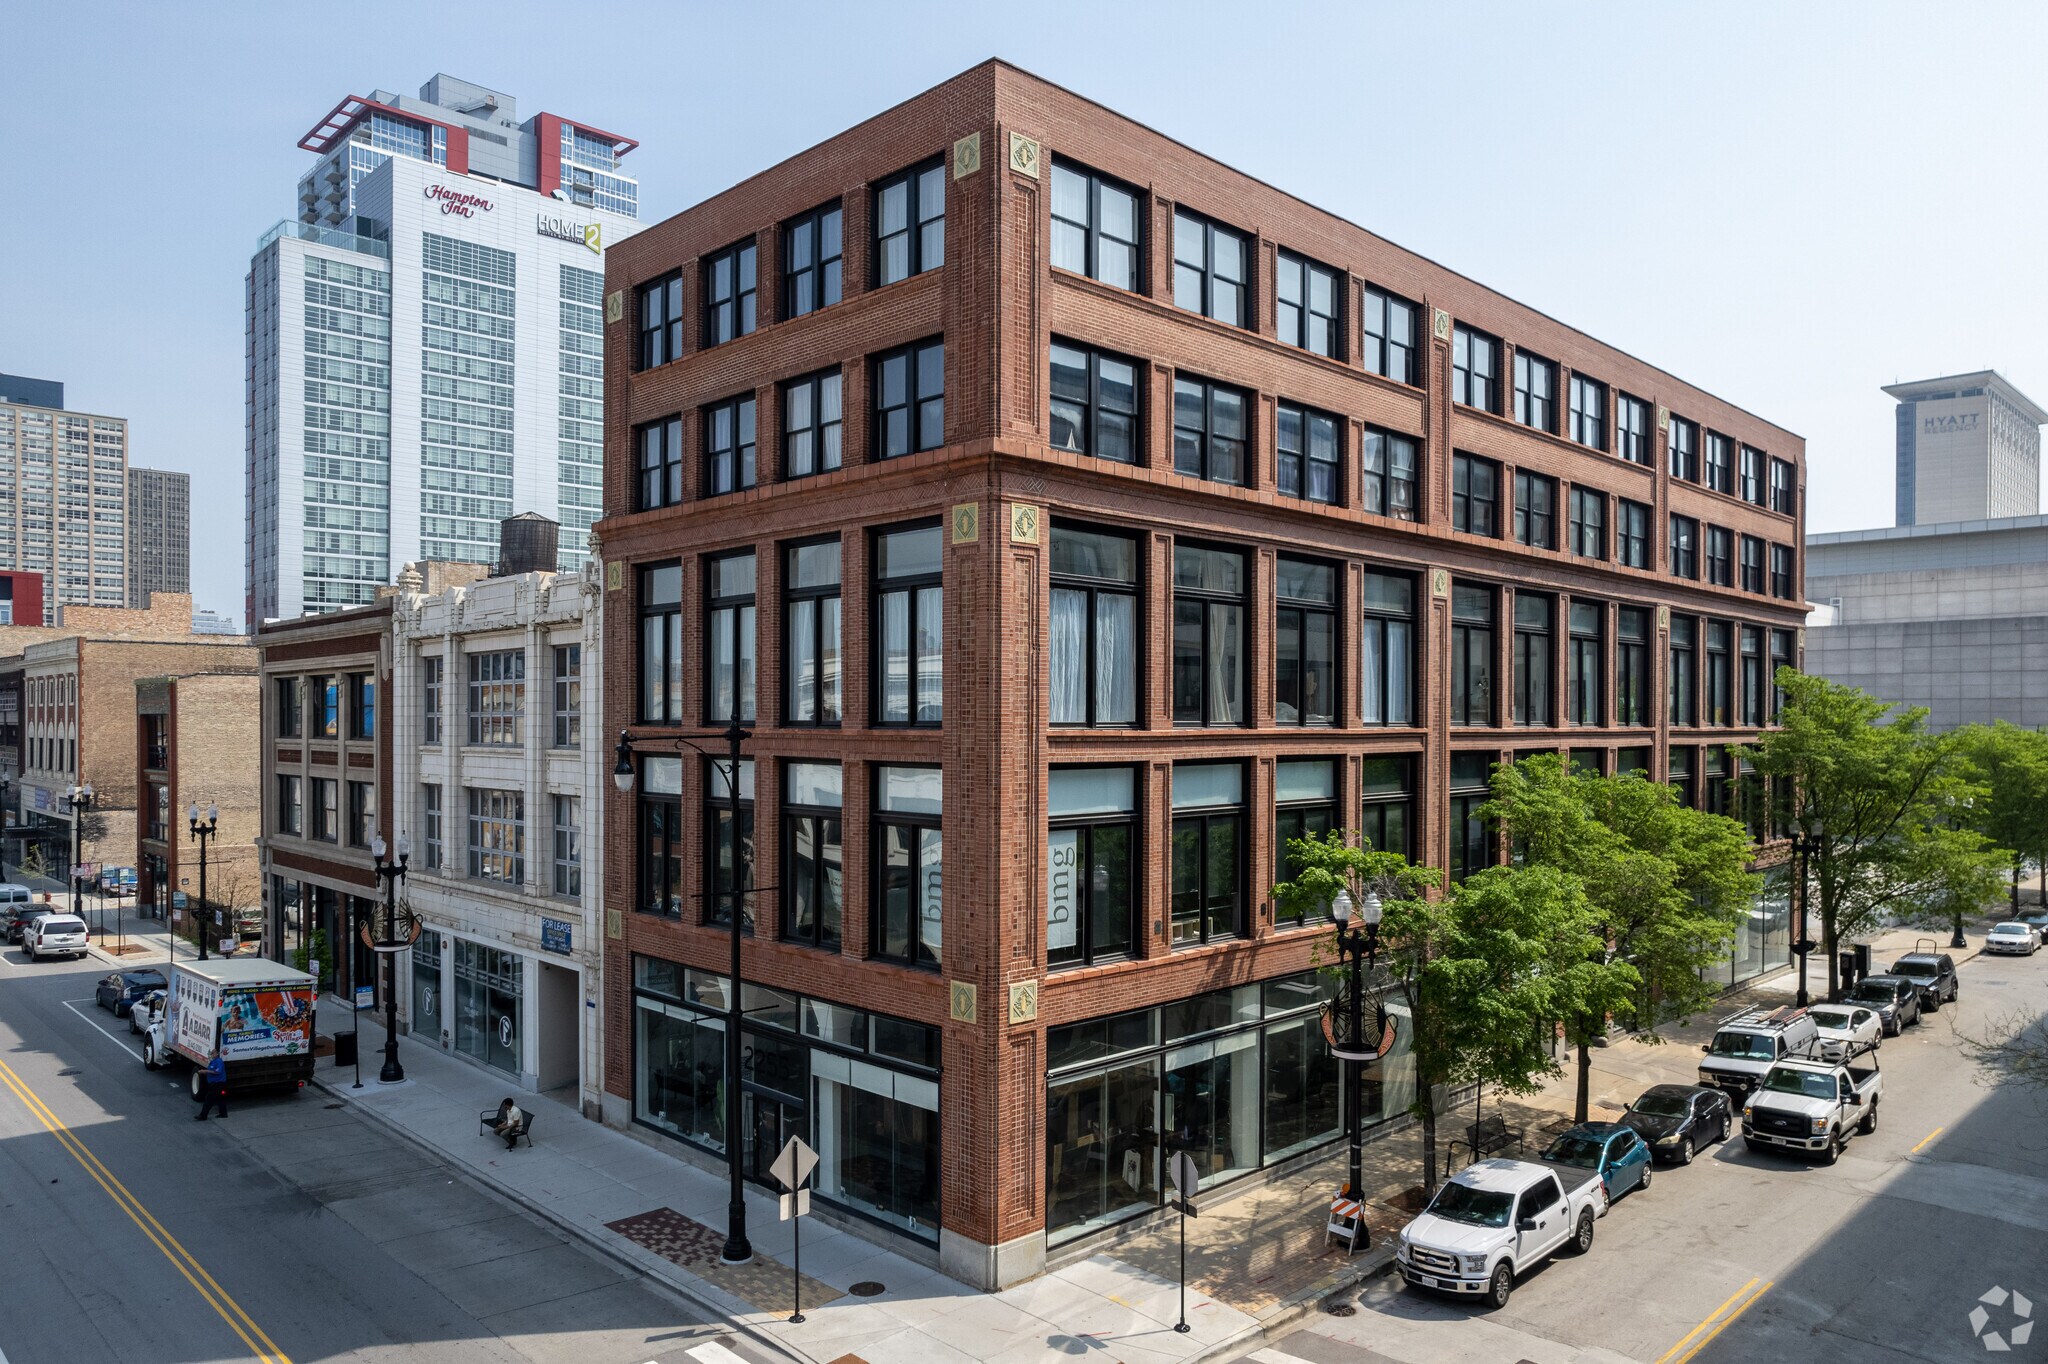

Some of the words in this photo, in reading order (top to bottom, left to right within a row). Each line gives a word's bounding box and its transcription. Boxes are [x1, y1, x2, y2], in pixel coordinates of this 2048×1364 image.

[425, 185, 493, 211] Hampton
[442, 201, 474, 218] Inn
[1925, 413, 1980, 427] HYATT
[1925, 423, 1979, 434] REGENCY
[1047, 846, 1076, 925] bmg
[543, 918, 554, 929] FOR
[553, 921, 571, 934] LEASE
